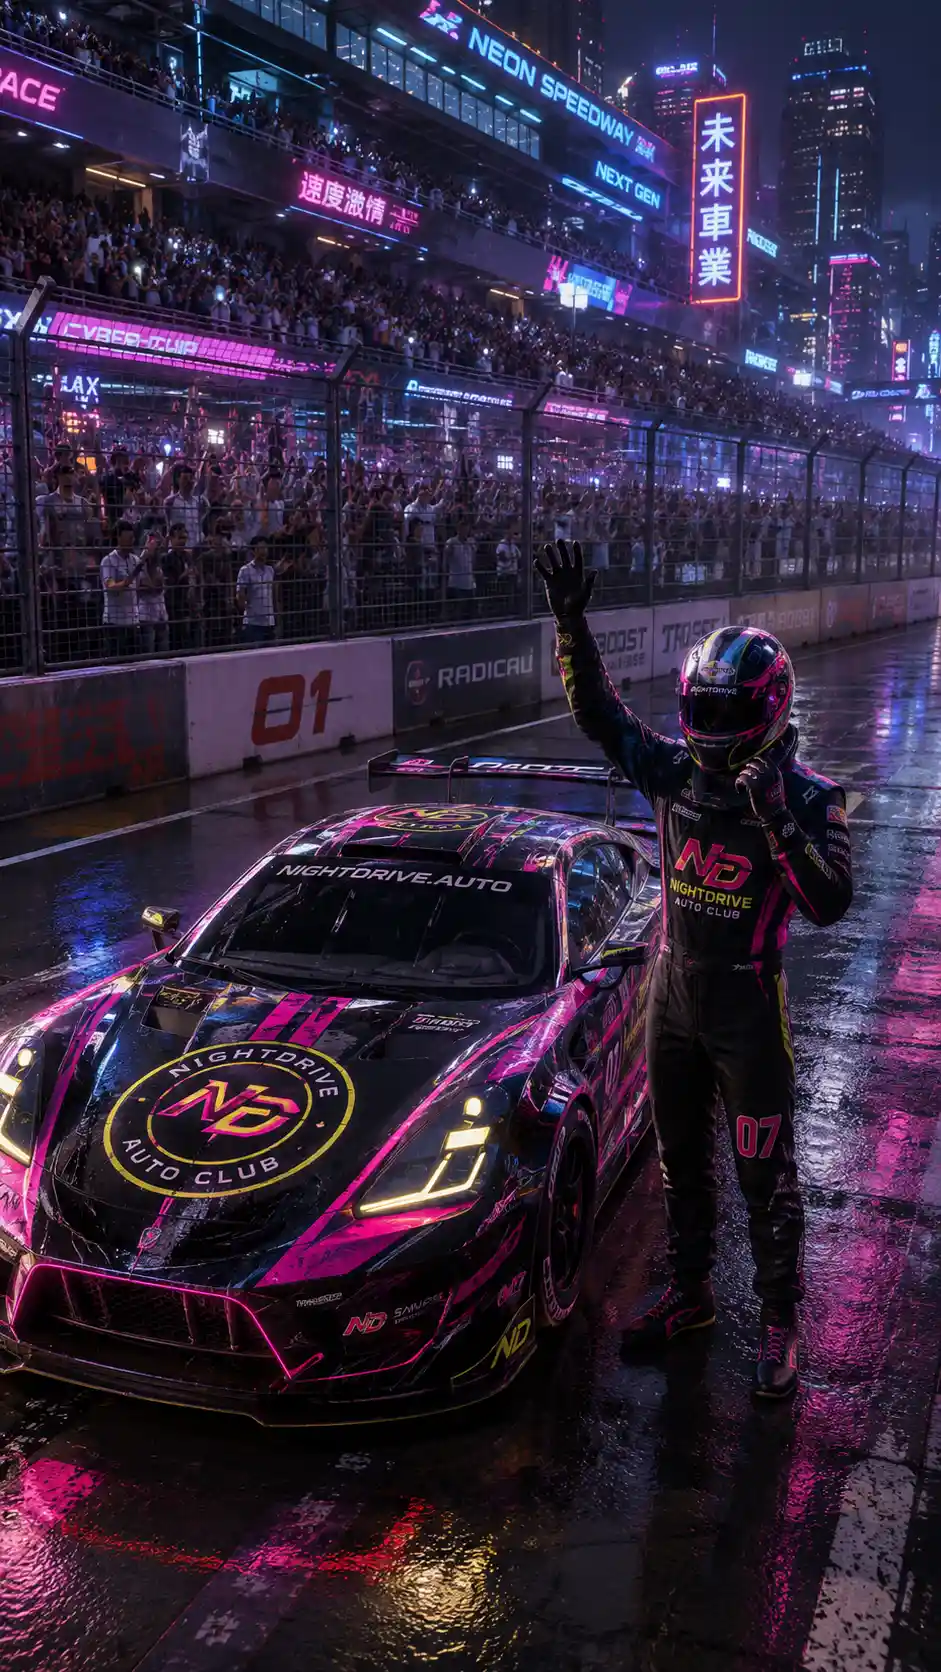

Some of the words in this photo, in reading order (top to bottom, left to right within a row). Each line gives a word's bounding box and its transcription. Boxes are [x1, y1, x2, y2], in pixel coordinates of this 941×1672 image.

[0, 67, 61, 111] ACE
[468, 27, 536, 88] NEON
[540, 73, 634, 147] SPEEDWAY
[595, 160, 634, 193] NEXT
[634, 182, 661, 209] GEN
[698, 112, 735, 287] 未来車業
[251, 669, 333, 747] 01
[277, 864, 513, 893] NIGHTDRIVE.AUTO
[674, 837, 753, 890] ND
[669, 878, 753, 909] NIGHTDRIVE
[674, 897, 702, 912] AUTO
[706, 906, 741, 919] CLUB
[168, 1048, 340, 1098] NIGHTDRIVE
[736, 1114, 782, 1159] 07
[122, 1138, 181, 1182] AUTO
[194, 1155, 280, 1185] CLUB
[343, 1311, 388, 1337] ND
[490, 1317, 531, 1369] ND
